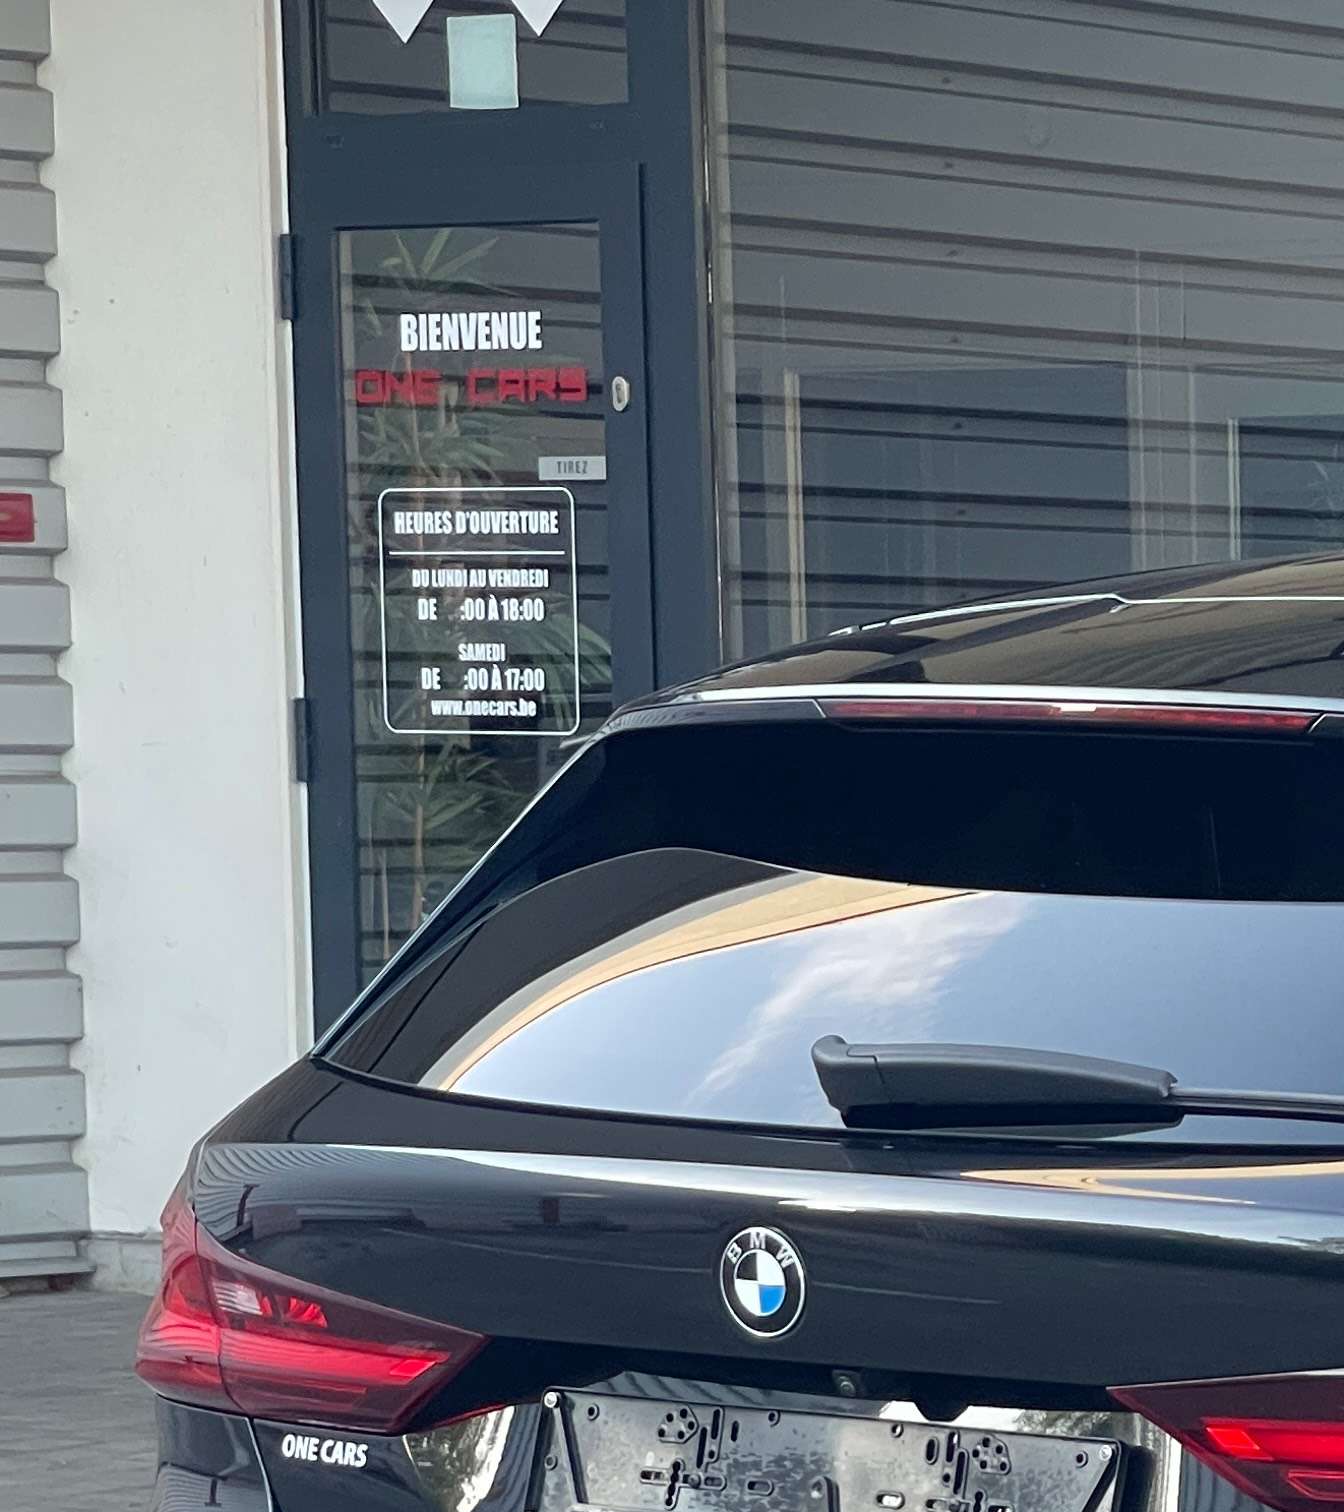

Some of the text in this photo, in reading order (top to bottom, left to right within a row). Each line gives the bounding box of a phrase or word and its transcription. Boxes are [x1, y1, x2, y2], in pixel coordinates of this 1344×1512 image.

[400, 311, 543, 351] BIENVENUE
[355, 366, 589, 407] ONE CARS
[556, 461, 589, 475] TIREZ
[394, 510, 559, 534] HEURES D'OUVERTURE
[412, 569, 549, 587] DU LUNDI AU VENDREDI
[417, 598, 438, 621] DE
[488, 594, 499, 621] À
[501, 597, 545, 621] 18:00
[458, 643, 506, 662] SAMEDI
[421, 667, 441, 690] DE
[491, 663, 502, 691] À
[504, 668, 545, 691] 17:00
[430, 698, 537, 717] www.onecars.be
[281, 1433, 369, 1468] ONE CARS
